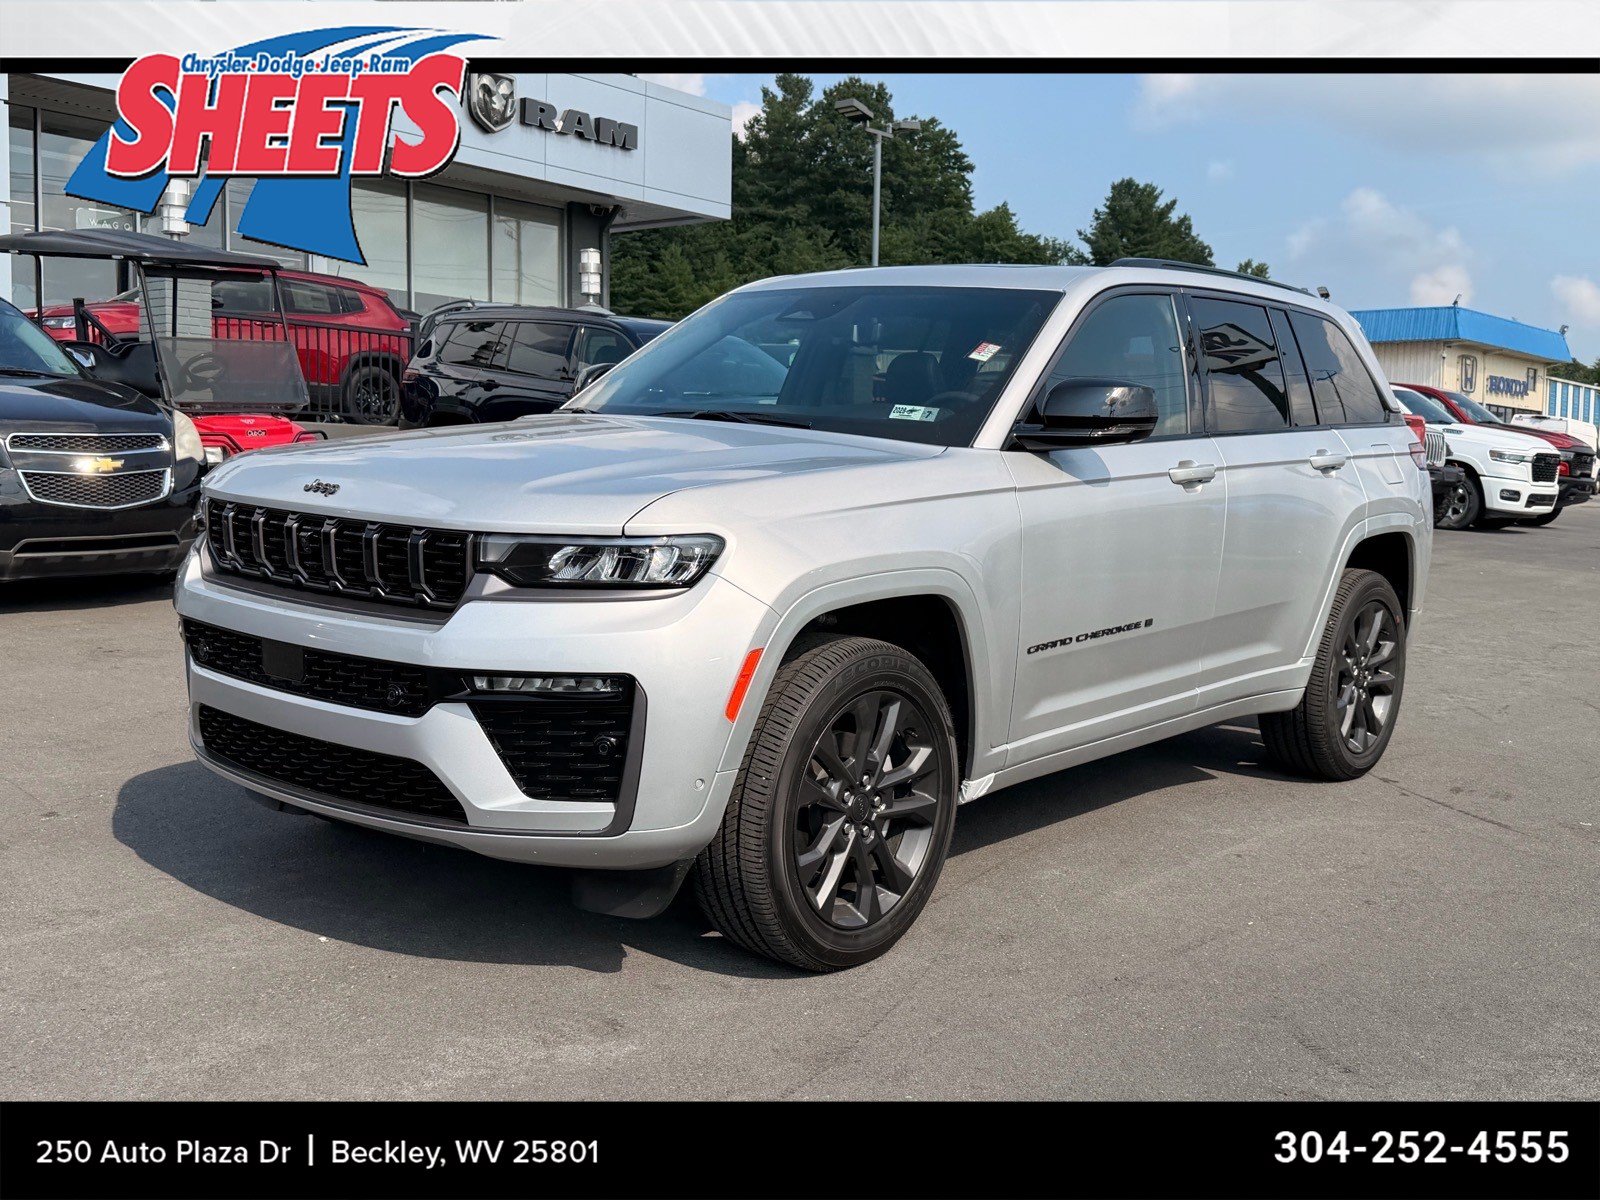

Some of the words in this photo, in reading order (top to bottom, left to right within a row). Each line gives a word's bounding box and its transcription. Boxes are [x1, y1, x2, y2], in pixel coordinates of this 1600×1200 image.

[520, 97, 638, 150] RAM
[1489, 375, 1529, 397] HONDA
[303, 479, 340, 497] Jeep
[1027, 637, 1073, 655] GRAND
[1075, 621, 1142, 643] CHEROKEE
